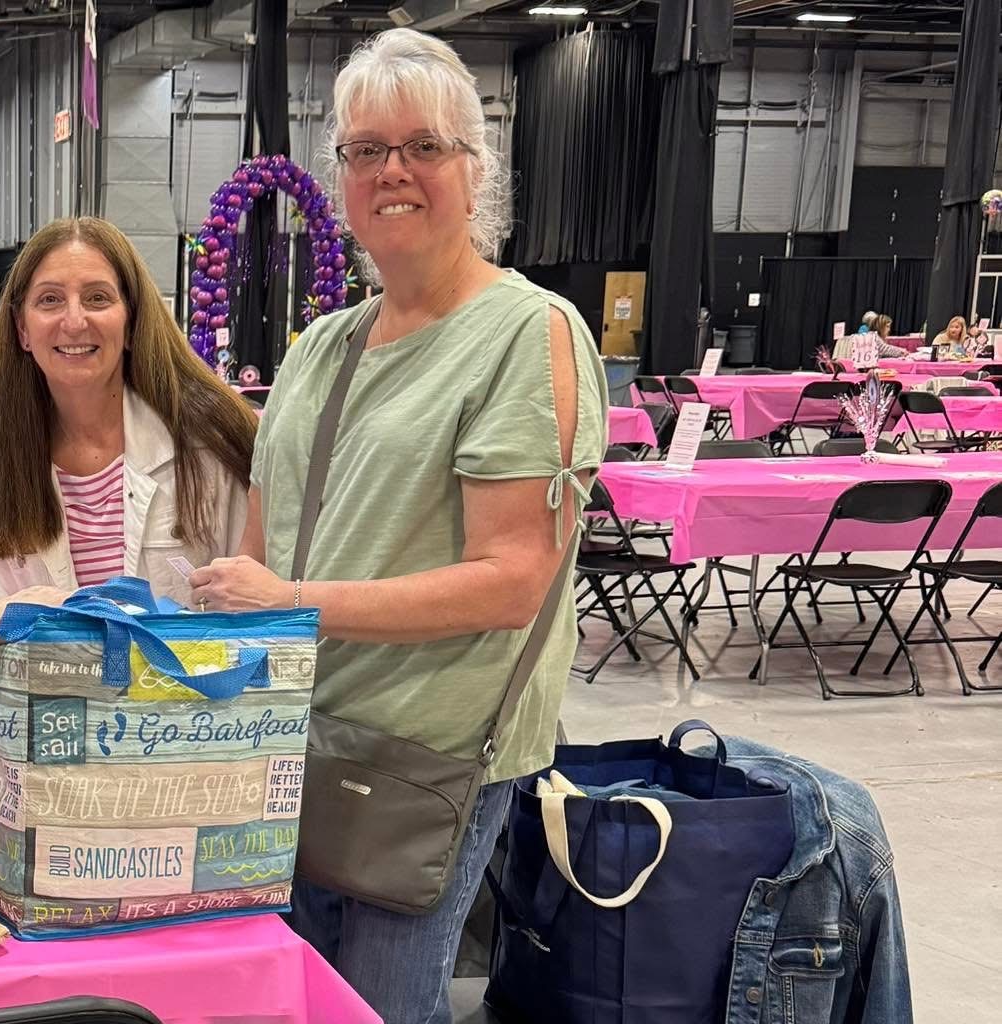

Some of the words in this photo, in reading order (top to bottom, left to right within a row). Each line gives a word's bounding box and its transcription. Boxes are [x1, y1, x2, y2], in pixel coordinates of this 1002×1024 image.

[41, 712, 78, 734] Set
[138, 712, 183, 755] Go
[186, 708, 309, 749] Barefoot
[41, 736, 78, 757] sail
[272, 760, 293, 771] LIFE
[294, 760, 303, 771] IS
[38, 777, 108, 819] SOAK
[113, 777, 148, 819] UP
[151, 774, 197, 817] THE
[197, 774, 248, 815] SUN
[268, 788, 281, 799] AT
[282, 787, 300, 799] THE
[266, 802, 297, 814] BEACH
[200, 835, 236, 862] SEAS
[244, 829, 269, 856] THE
[49, 845, 71, 877] BUILD
[74, 846, 183, 880] SANDCASTLES
[34, 904, 114, 924] RELAX
[125, 902, 157, 919] IT'S
[163, 900, 176, 916] A
[184, 895, 244, 914] SHORE
[251, 889, 290, 906] THIN
